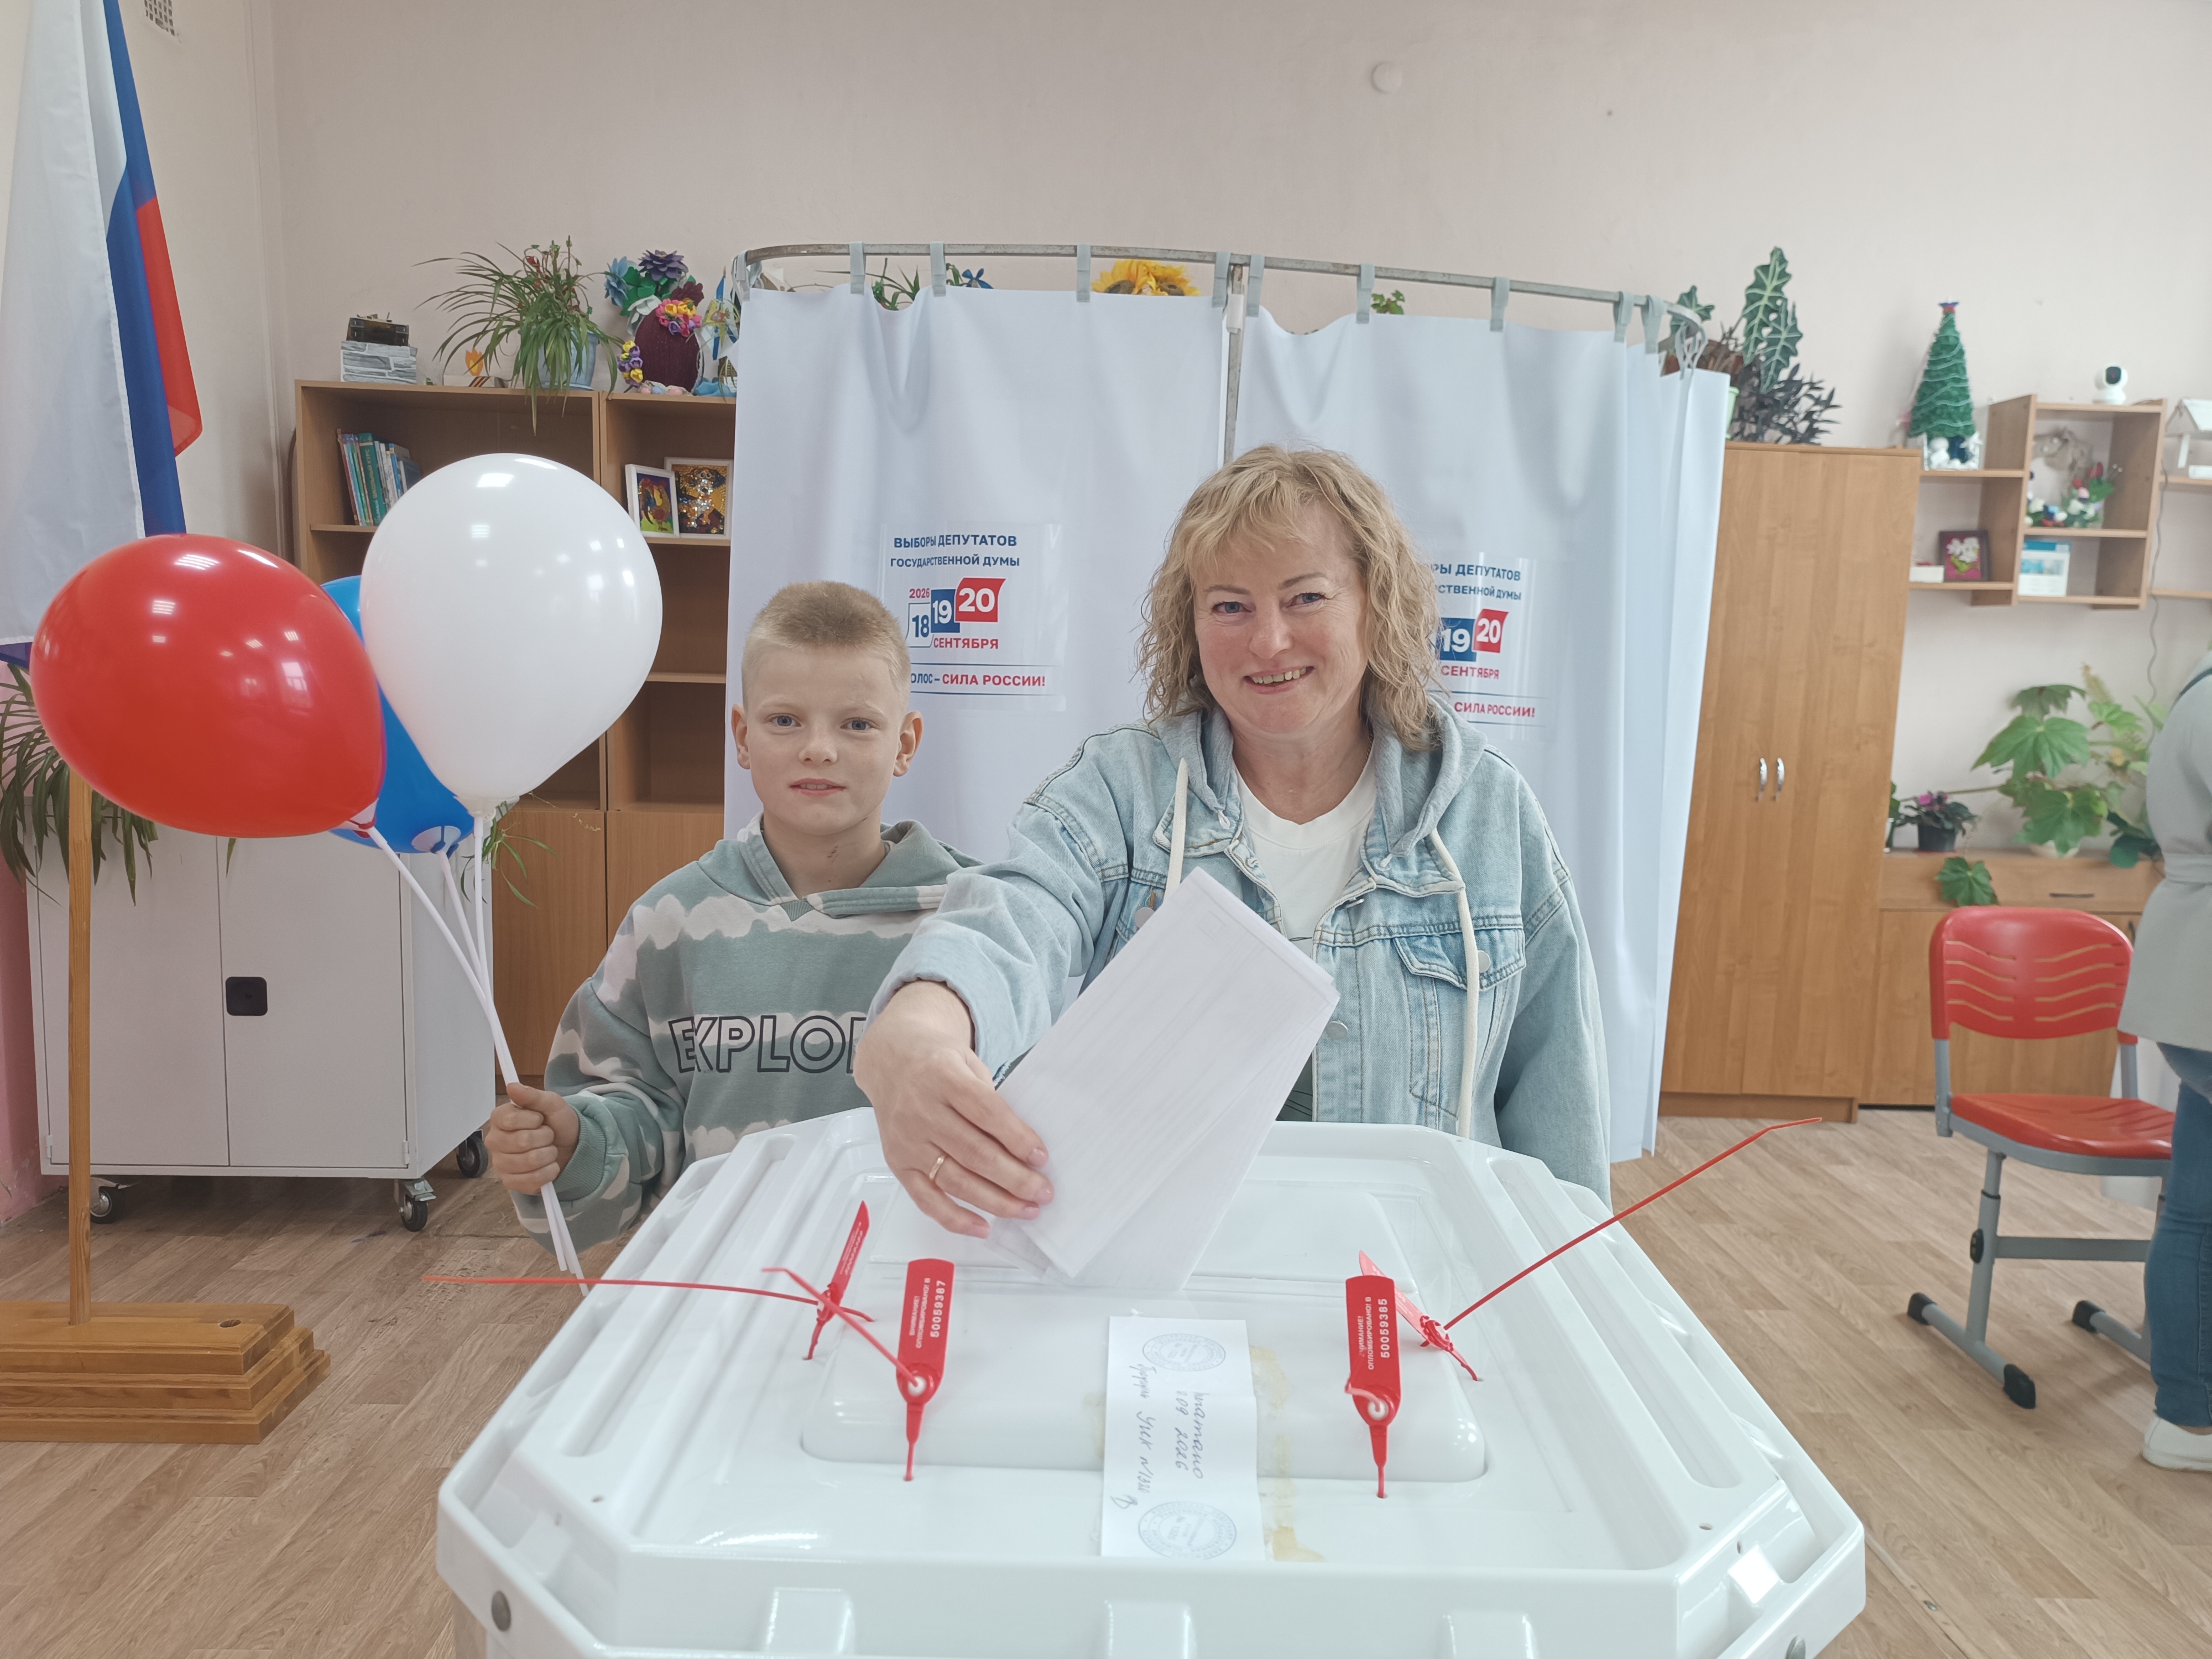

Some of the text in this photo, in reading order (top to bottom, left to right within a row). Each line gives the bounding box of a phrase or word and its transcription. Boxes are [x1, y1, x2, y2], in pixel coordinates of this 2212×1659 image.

[894, 534, 1017, 548] ВЫБОРЫ ДЕПУТАТОВ
[890, 554, 1020, 568] ГОСУДАРСТВЕННОЙ ДУМЫ
[1455, 564, 1521, 581] ДЕПУТАТОВ
[909, 588, 930, 599] 2026
[1434, 585, 1521, 601] СТВЕННОЙ ДУМЫ
[912, 587, 995, 638] 18 19 20
[933, 638, 999, 649] СЕНТЯБРЯ
[1441, 618, 1501, 653] 19 20
[911, 673, 933, 684] ОЛОС
[942, 674, 979, 685] СИЛА
[983, 675, 1045, 686] РОССИИ!
[1441, 665, 1499, 679] СЕНТЯБРЯ
[1454, 702, 1535, 717] СИЛА РОССИИ!
[930, 1280, 946, 1338] 50059387
[1365, 1303, 1374, 1370] ОПЛОМБИРОВАНО!
[1379, 1299, 1390, 1358] 50059385
[1175, 1427, 1189, 1471] 2026
